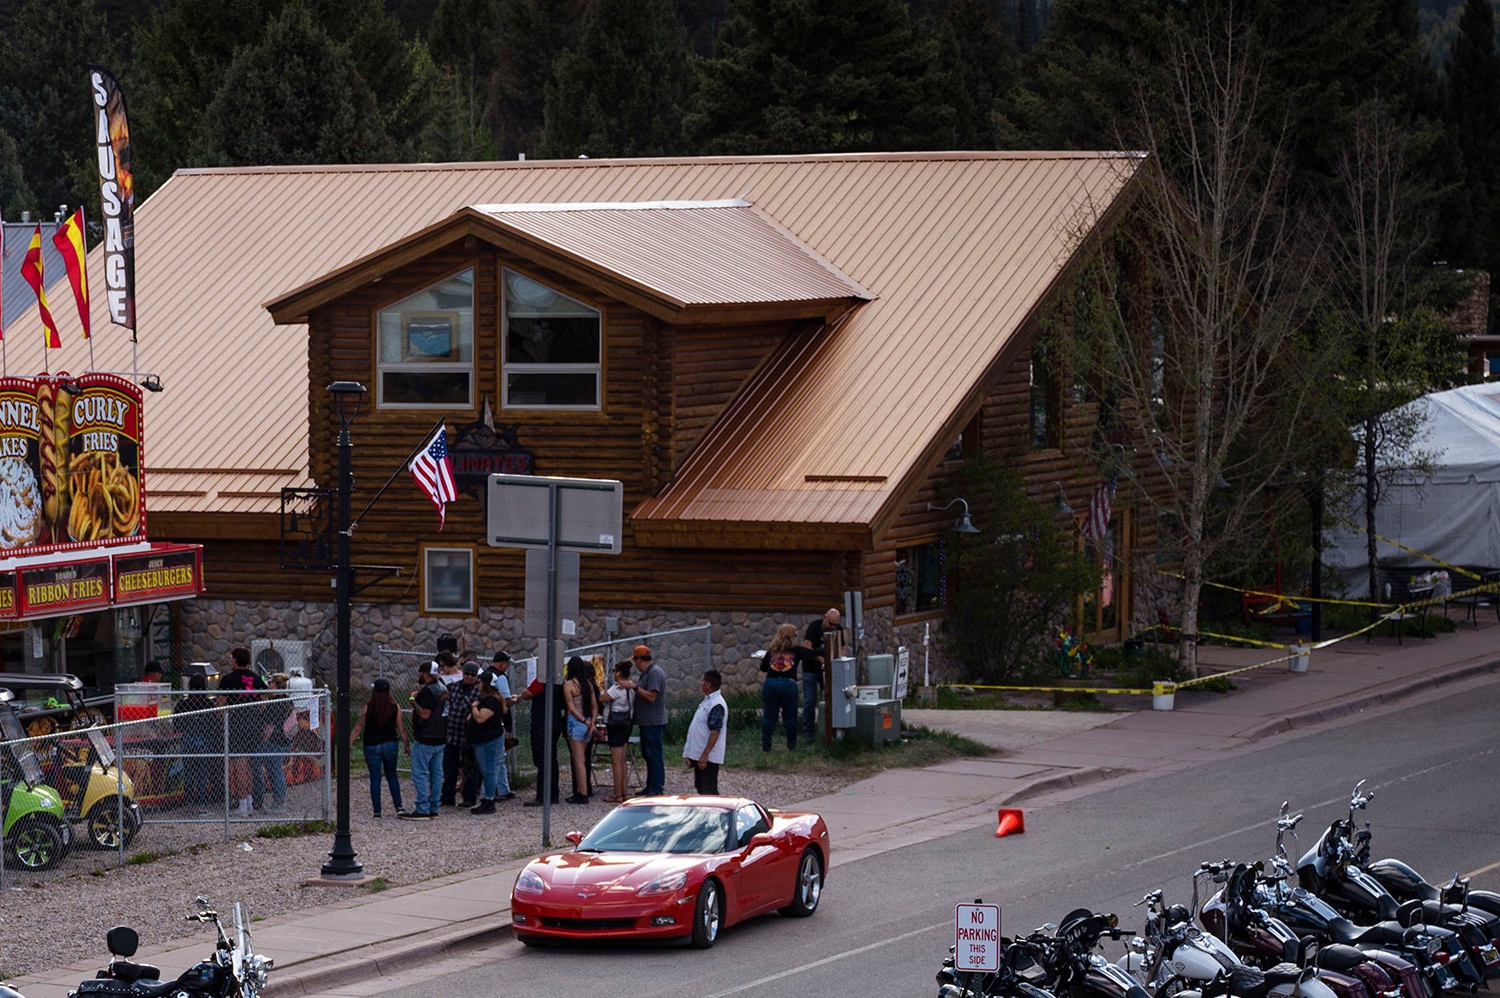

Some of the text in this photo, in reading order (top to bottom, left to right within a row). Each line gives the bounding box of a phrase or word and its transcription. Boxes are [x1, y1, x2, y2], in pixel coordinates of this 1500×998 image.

[91, 72, 127, 324] SAUSAGE
[73, 397, 127, 427] CURLY
[83, 431, 118, 453] FRIES
[451, 456, 528, 473] LIMATES
[119, 567, 192, 592] CHEESEBURGERS
[28, 579, 103, 605] RIBBON FRIES
[971, 911, 984, 924] NO
[959, 928, 997, 942] PARKING
[969, 944, 986, 953] THIS
[969, 955, 985, 965] SIDE
